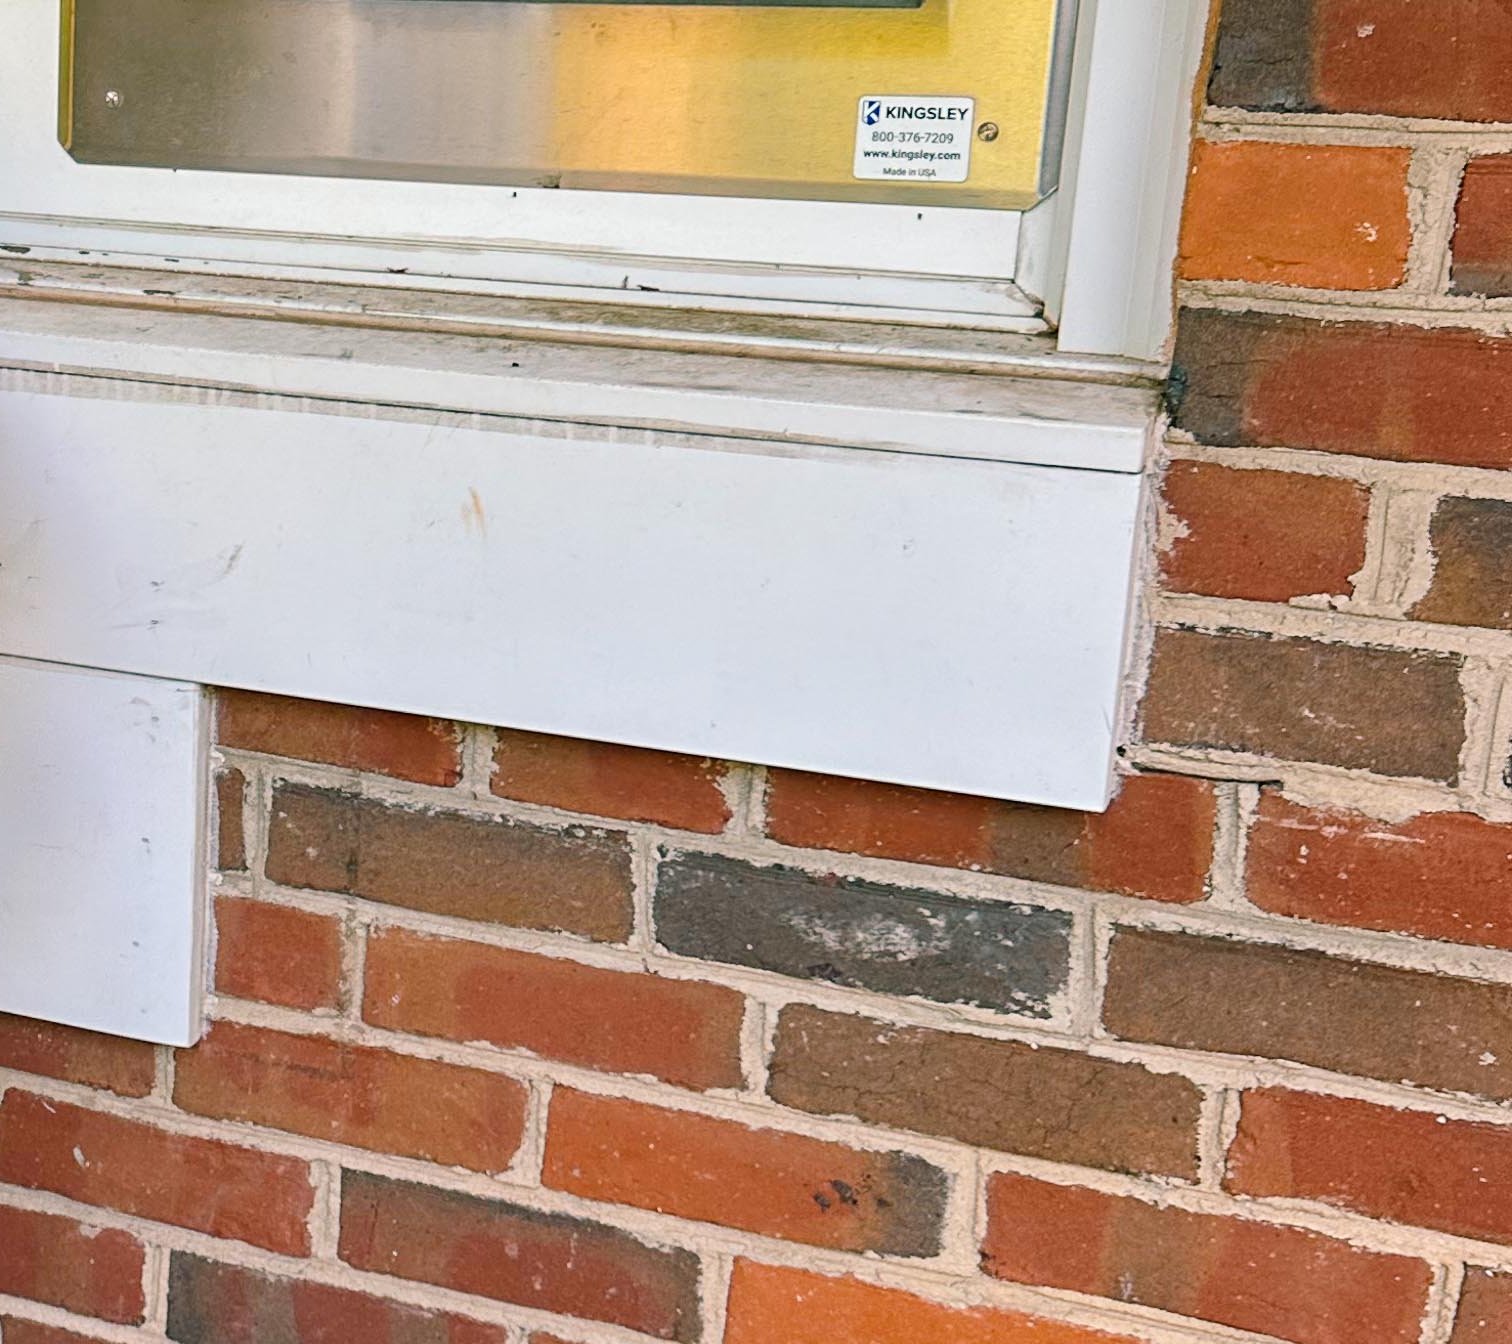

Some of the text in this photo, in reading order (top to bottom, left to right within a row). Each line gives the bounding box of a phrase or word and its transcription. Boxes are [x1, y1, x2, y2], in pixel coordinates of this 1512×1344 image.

[885, 106, 969, 121] KINGSLEY
[871, 131, 954, 144] 800-376-7209
[863, 149, 962, 162] www.kingsley.com
[882, 167, 937, 177] Made in USA
